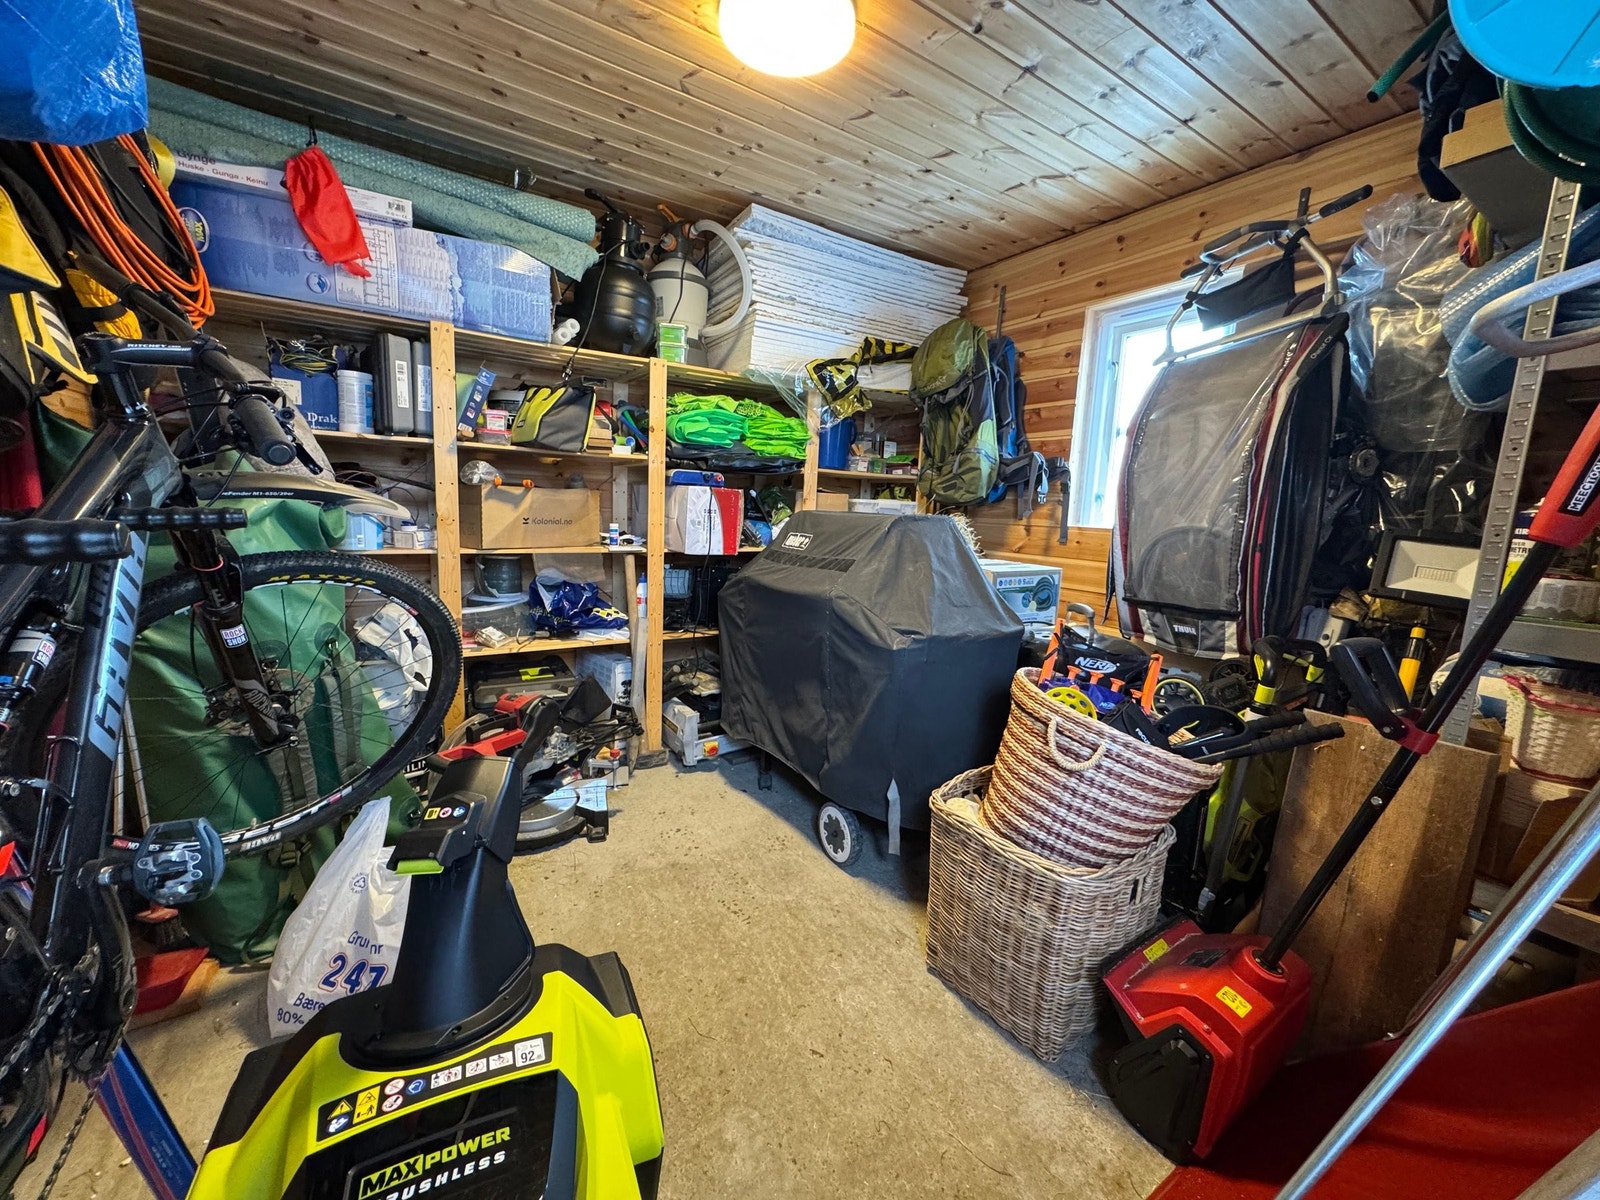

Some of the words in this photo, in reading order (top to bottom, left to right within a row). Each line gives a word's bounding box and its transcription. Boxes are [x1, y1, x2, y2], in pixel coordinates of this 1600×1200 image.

[178, 161, 204, 172] Huske
[212, 168, 239, 180] Gunga
[246, 176, 269, 186] Keinu
[306, 412, 340, 425] Drak
[532, 517, 573, 525] Kolonial.no
[223, 628, 244, 639] ROCK
[226, 634, 246, 646] SHOX
[1074, 656, 1114, 672] NERF
[319, 952, 389, 995] 247
[520, 1050, 536, 1064] 92
[360, 1156, 423, 1198] MAX
[424, 1126, 512, 1170] POWER
[379, 1150, 506, 1200] RUSHLESS
